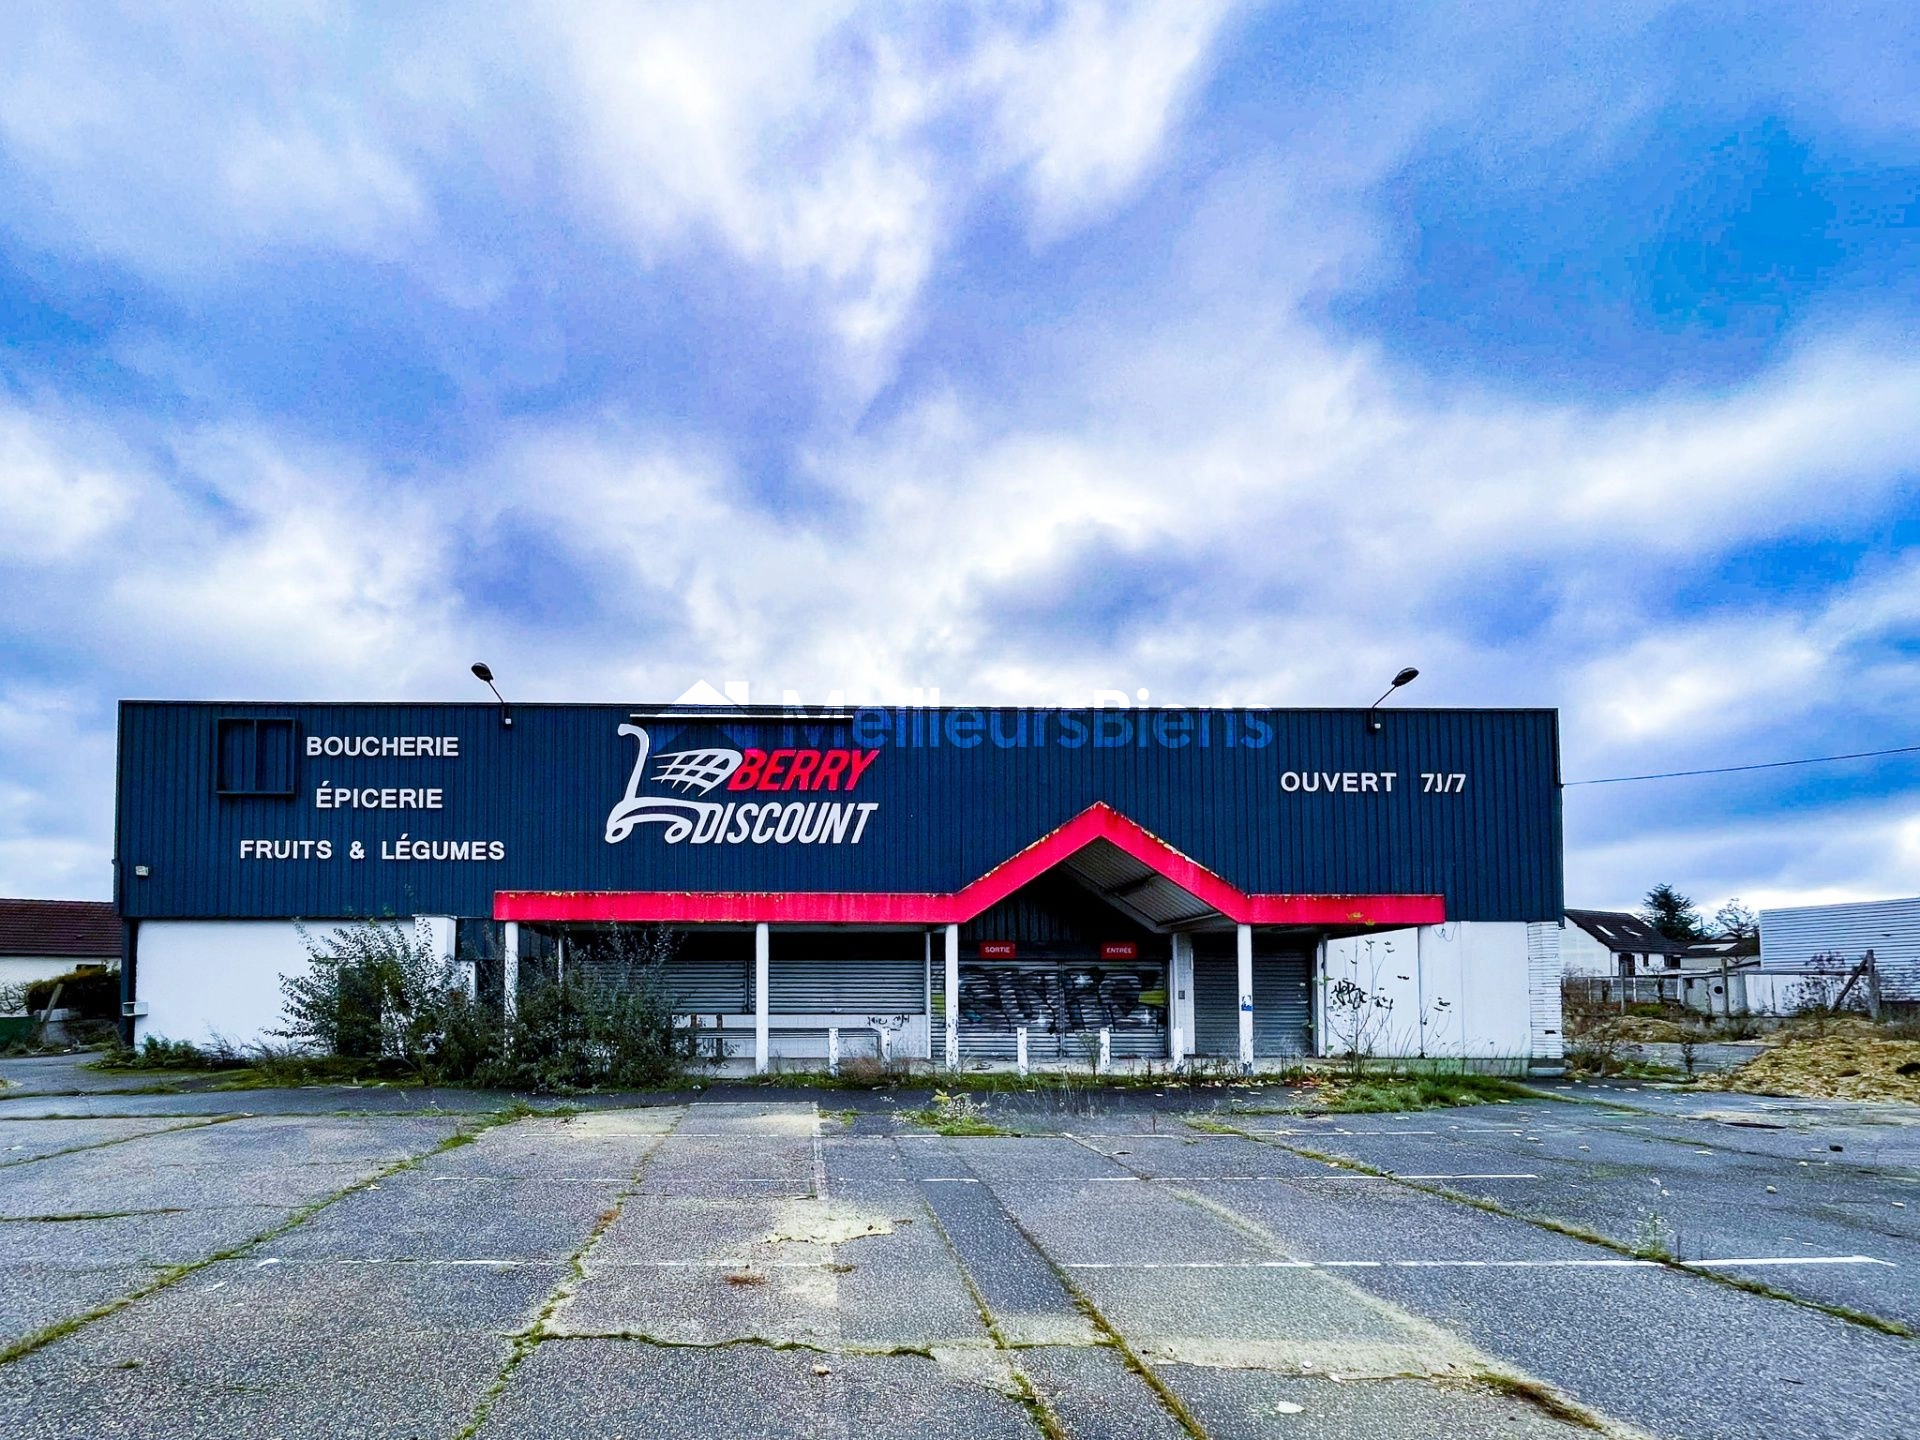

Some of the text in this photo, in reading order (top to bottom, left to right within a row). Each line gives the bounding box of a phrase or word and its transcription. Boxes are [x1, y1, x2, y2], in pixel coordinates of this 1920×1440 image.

[306, 736, 459, 757] BOUCHERIE
[727, 748, 880, 791] BERRY
[1280, 771, 1467, 793] OUVERT 7J/7
[316, 780, 443, 809] ÉPICERIE
[690, 802, 879, 844] DISCOUNT
[240, 833, 505, 861] FRUITS & LÉGUMES
[1106, 946, 1132, 954] ENTRÉE
